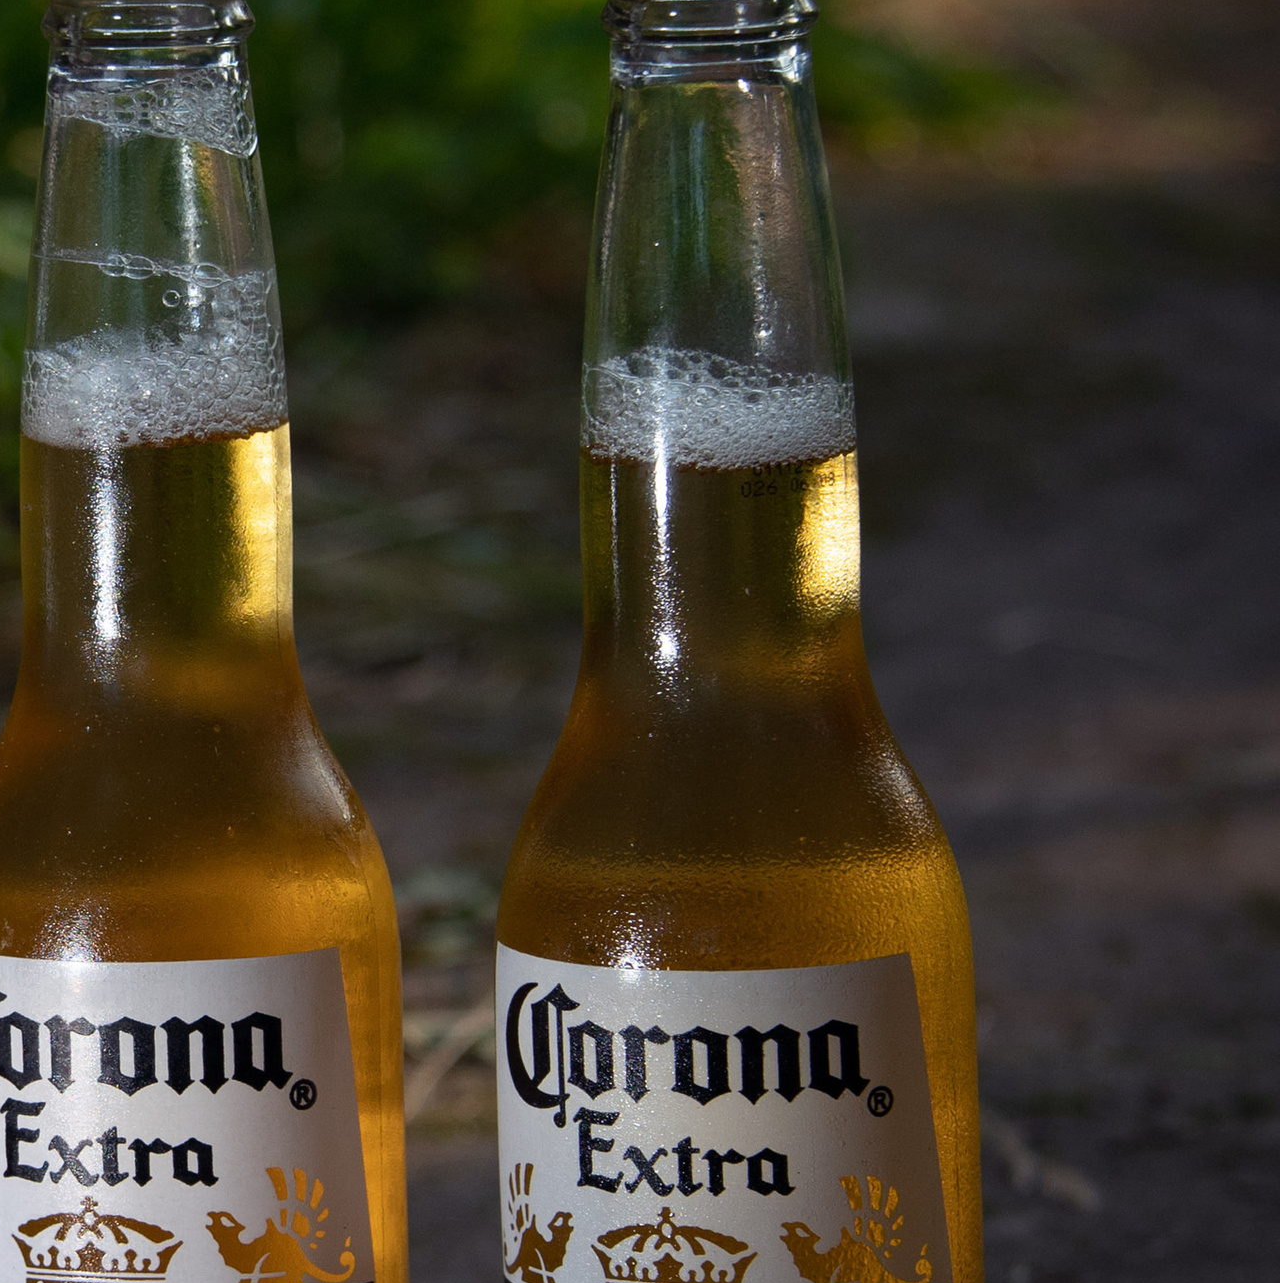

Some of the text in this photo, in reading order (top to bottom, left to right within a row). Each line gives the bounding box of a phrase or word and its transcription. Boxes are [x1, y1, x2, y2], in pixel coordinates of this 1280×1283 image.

[506, 982, 870, 1128] Corona
[0, 1098, 219, 1187] Extra
[574, 1107, 796, 1197] Extra
